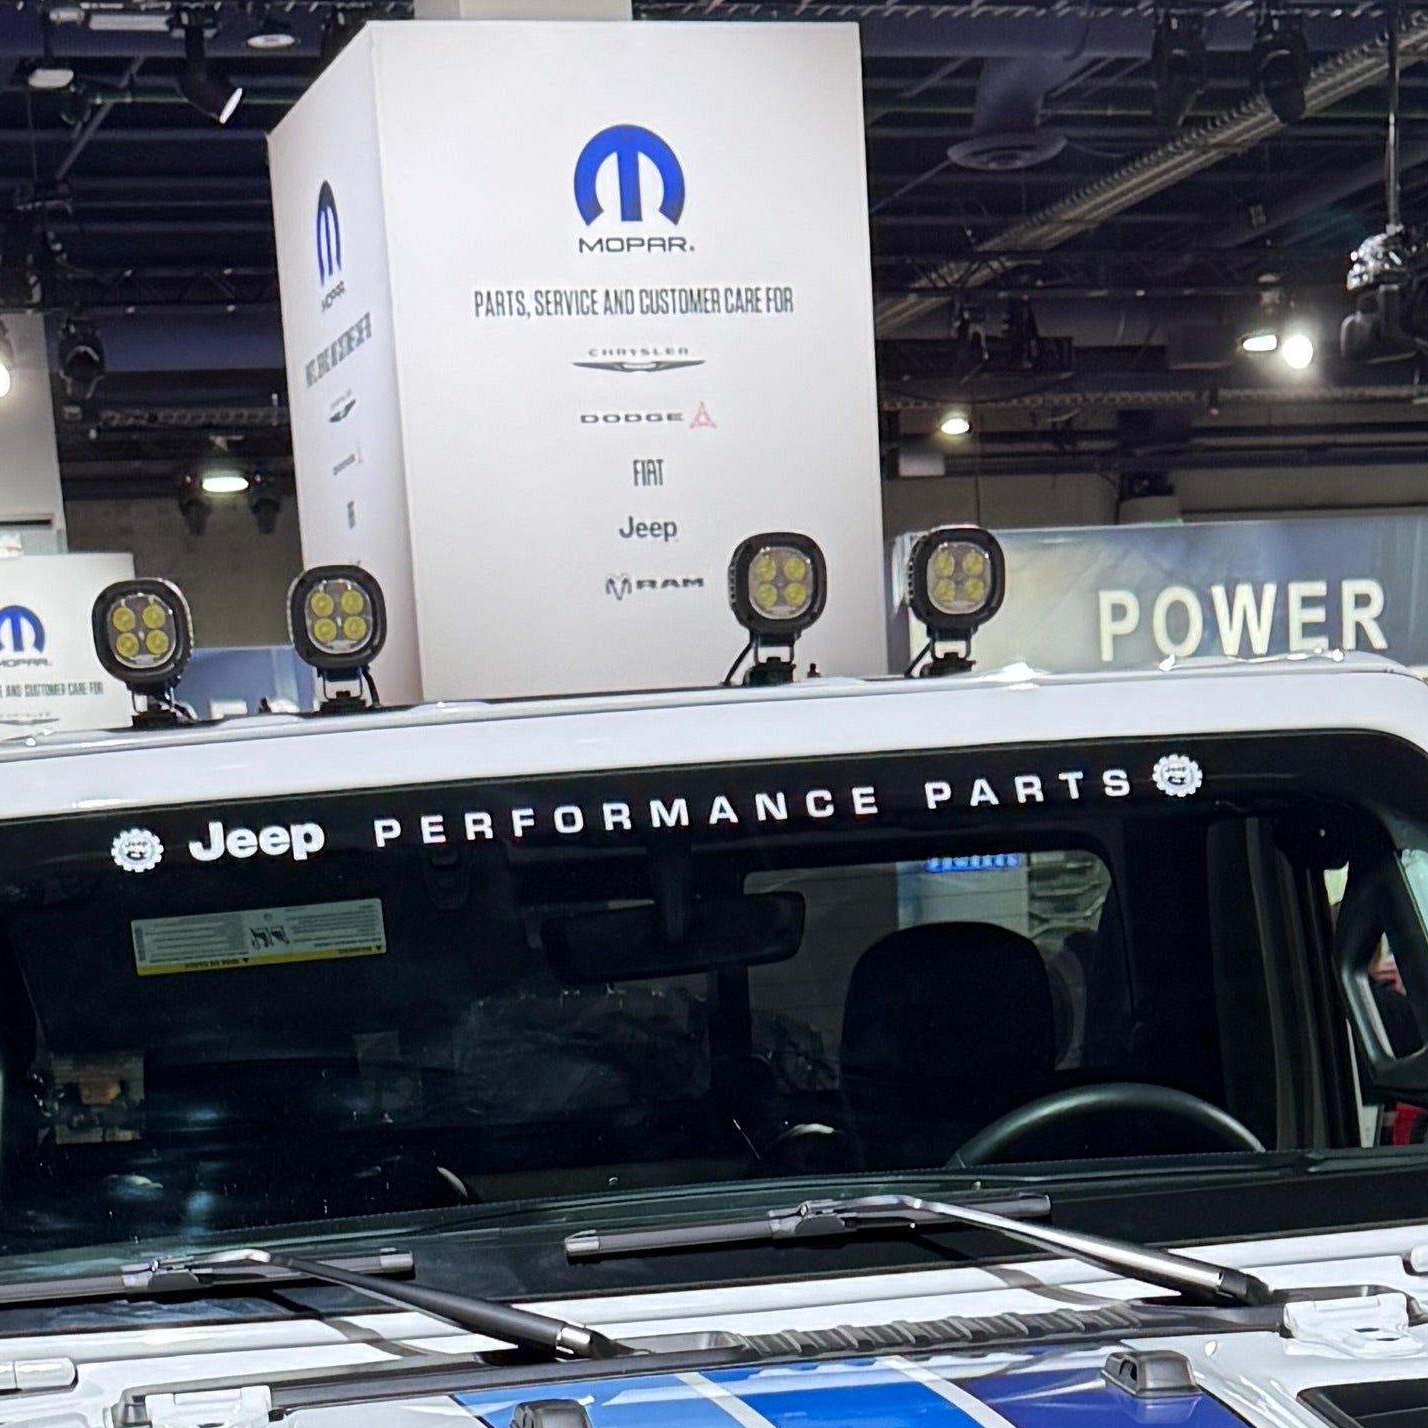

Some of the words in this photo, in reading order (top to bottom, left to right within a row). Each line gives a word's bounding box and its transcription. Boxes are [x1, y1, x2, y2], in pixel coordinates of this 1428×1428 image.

[474, 289, 531, 319] PARTS,
[534, 289, 598, 316] SERVICE
[603, 289, 635, 316] AND
[639, 287, 721, 315] CUSTOMER
[724, 287, 762, 314] CARE
[765, 286, 794, 313] FOR
[588, 347, 689, 357] CHRYSLER
[580, 413, 684, 424] DODGE
[633, 459, 664, 486] FIAT
[619, 516, 677, 542] Jeep
[636, 577, 705, 589] RAM
[1098, 578, 1388, 662] POWER
[188, 821, 325, 862] Jeep
[374, 786, 878, 848] PERFORMANCE
[924, 768, 1131, 810] PARTS
